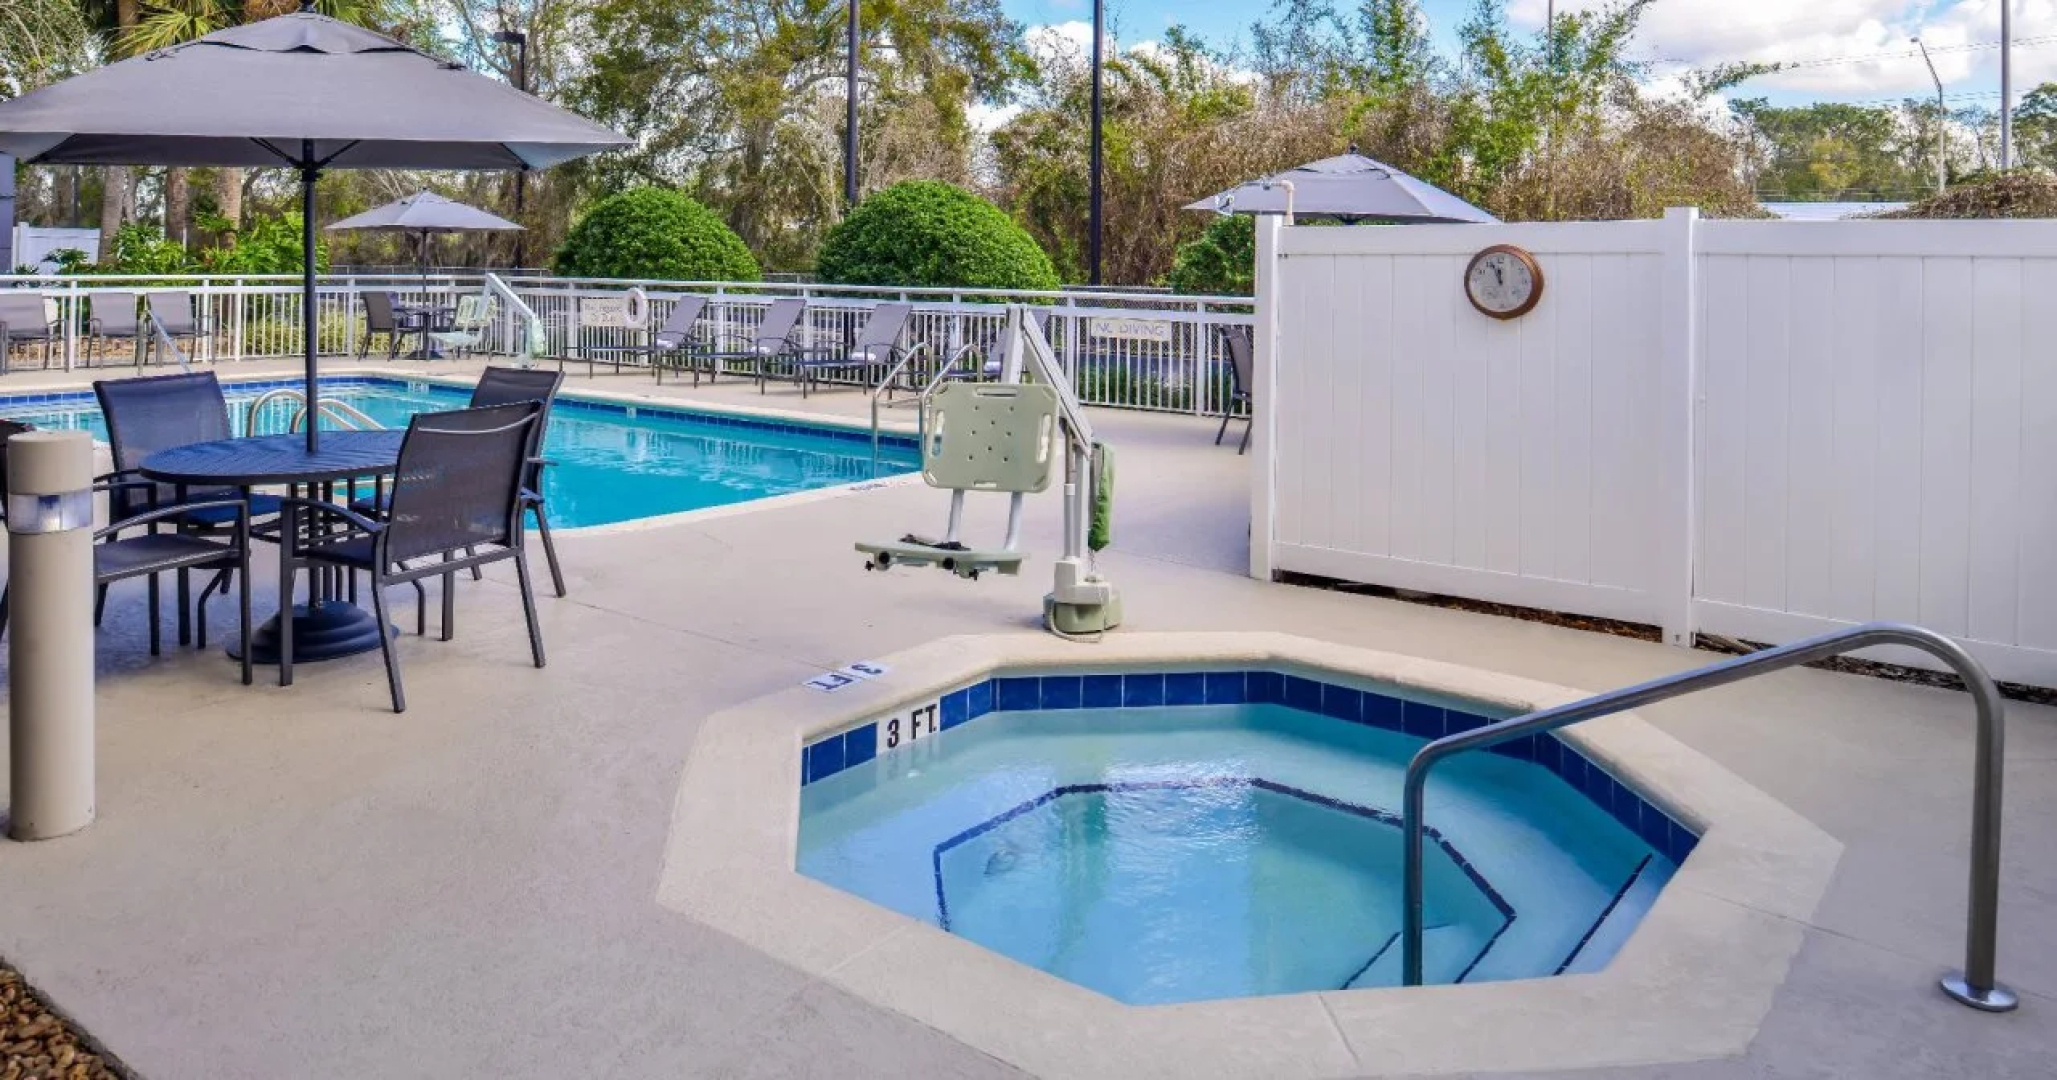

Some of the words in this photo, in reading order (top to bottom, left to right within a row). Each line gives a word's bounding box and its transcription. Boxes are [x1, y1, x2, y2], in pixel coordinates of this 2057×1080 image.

[1119, 322, 1165, 337] DIVING
[851, 663, 883, 674] 3
[887, 718, 900, 748] 3
[912, 703, 937, 740] FT.
